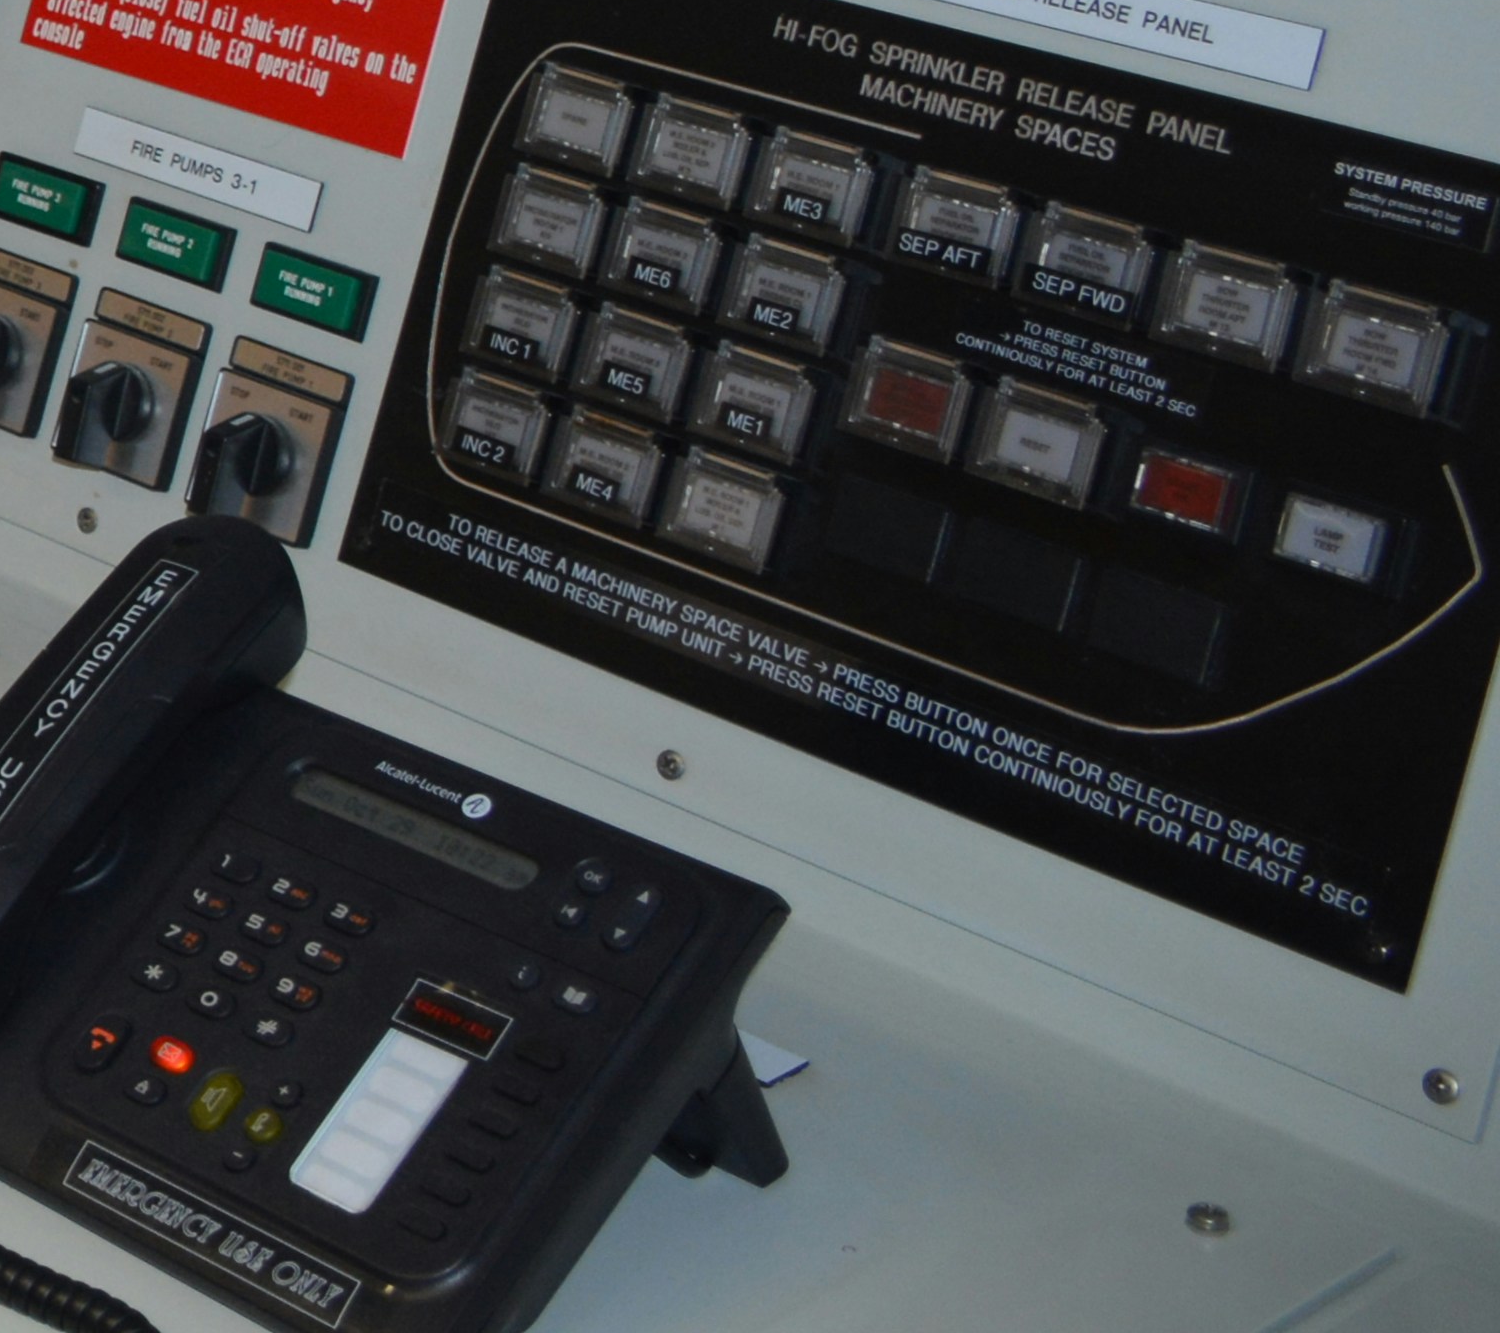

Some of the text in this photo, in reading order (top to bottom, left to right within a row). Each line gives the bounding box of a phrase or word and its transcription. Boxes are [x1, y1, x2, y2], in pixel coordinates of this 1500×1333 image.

[1141, 11, 1215, 45] PANEL
[773, 16, 1232, 156] HI-FOG SPRINKLER RELEASE PANEL
[859, 74, 1117, 162] MACHINERY SPACES
[130, 140, 259, 196] FIRE PUMPS 3-1
[1333, 161, 1488, 211] SYSTEM PRESSURE
[782, 193, 822, 221] ME3
[898, 232, 982, 269] SEP AFT
[634, 262, 672, 290] ME6
[1032, 271, 1126, 314] SEP FWD
[753, 301, 794, 330] ME2
[489, 333, 532, 360] INC 1
[607, 368, 644, 395] ME5
[726, 409, 763, 437] ME1
[461, 434, 505, 464] INC 2
[575, 472, 613, 501] ME4
[33, 570, 178, 738] EMERGENCY
[448, 514, 1307, 866] TO RELEASE A MACHINERY SPACE VALVE PRESS BUTTON ONCE FOR SELECTED SPACE
[374, 760, 462, 805] Alcatel-Lucent
[78, 1158, 344, 1308] EMERGENCY USE ONLY
